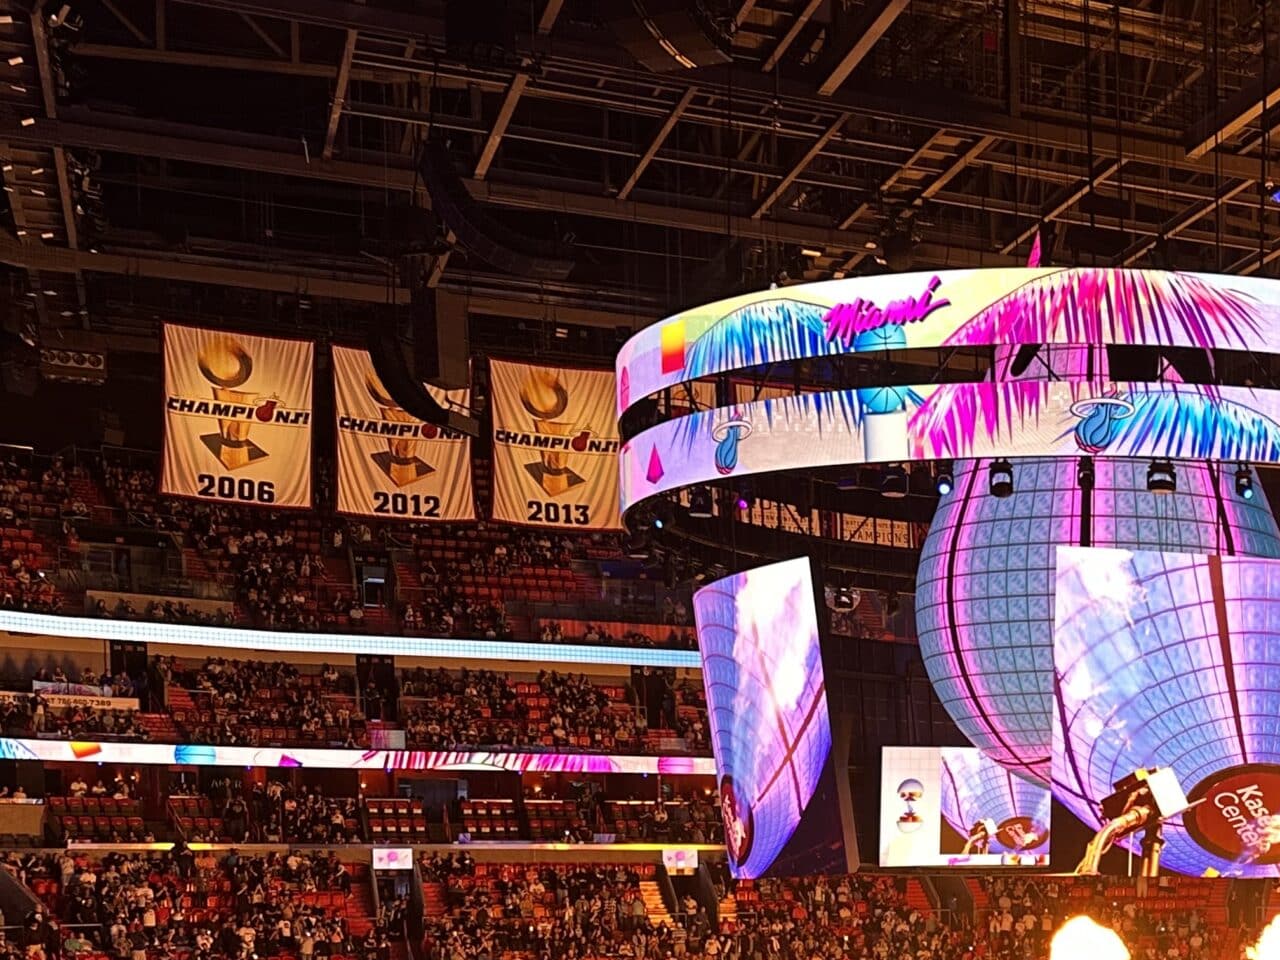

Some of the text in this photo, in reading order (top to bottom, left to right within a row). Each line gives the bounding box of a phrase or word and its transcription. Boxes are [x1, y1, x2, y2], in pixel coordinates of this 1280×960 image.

[822, 275, 951, 348] Miami
[197, 474, 275, 503] 2006
[373, 492, 440, 518] 2012
[527, 501, 590, 525] 2013
